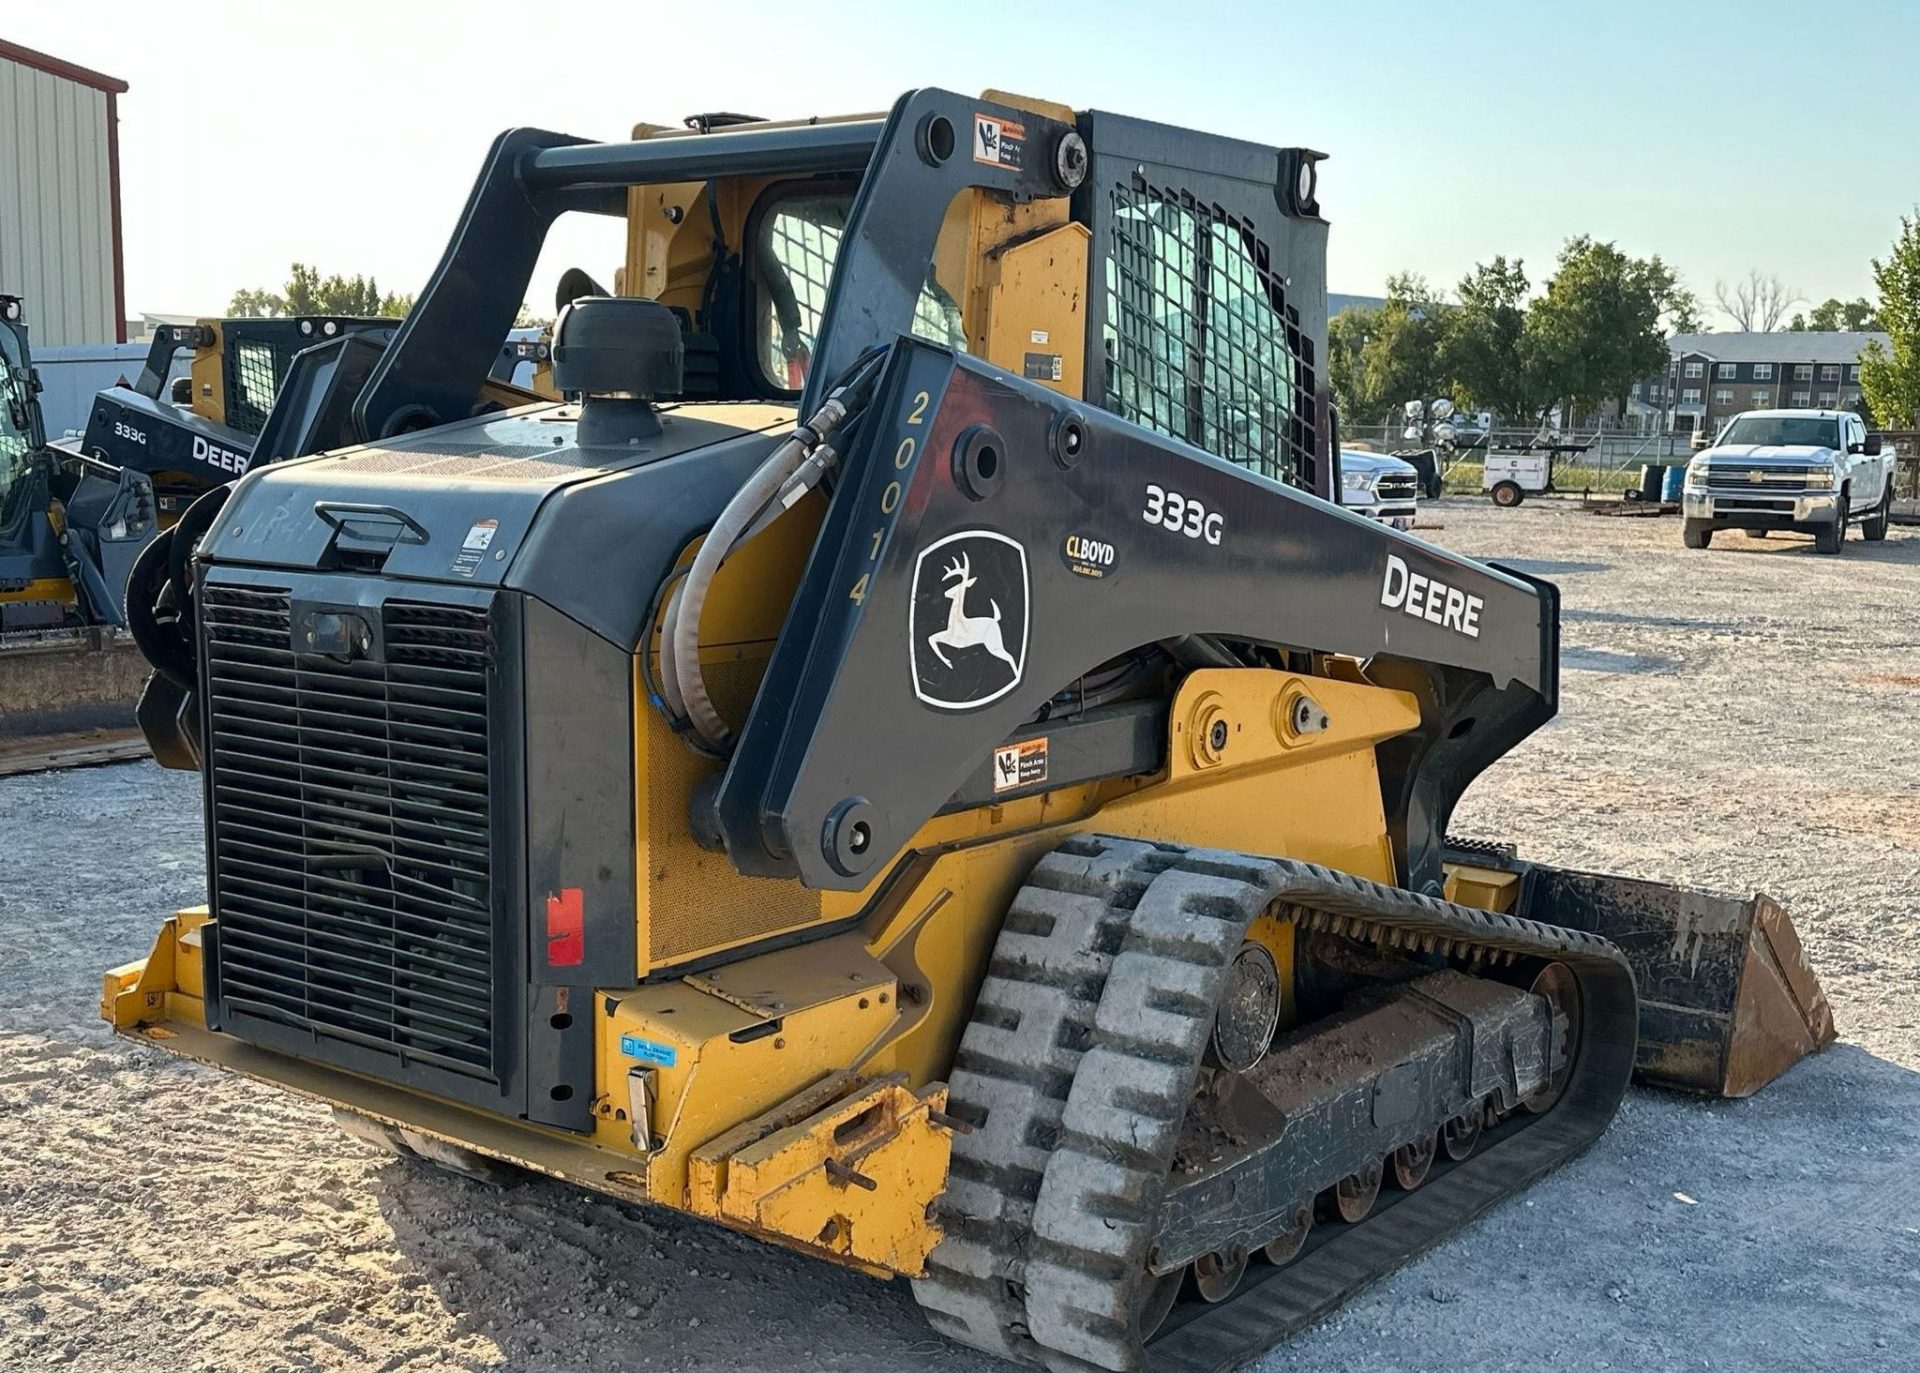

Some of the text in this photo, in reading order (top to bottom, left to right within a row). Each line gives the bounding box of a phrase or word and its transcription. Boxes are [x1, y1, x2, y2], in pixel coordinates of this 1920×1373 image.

[114, 421, 147, 445] 333G
[192, 435, 249, 475] DEER
[849, 391, 930, 607] 20014
[1142, 484, 1224, 546] 333G
[1380, 554, 1484, 638] DEERE
